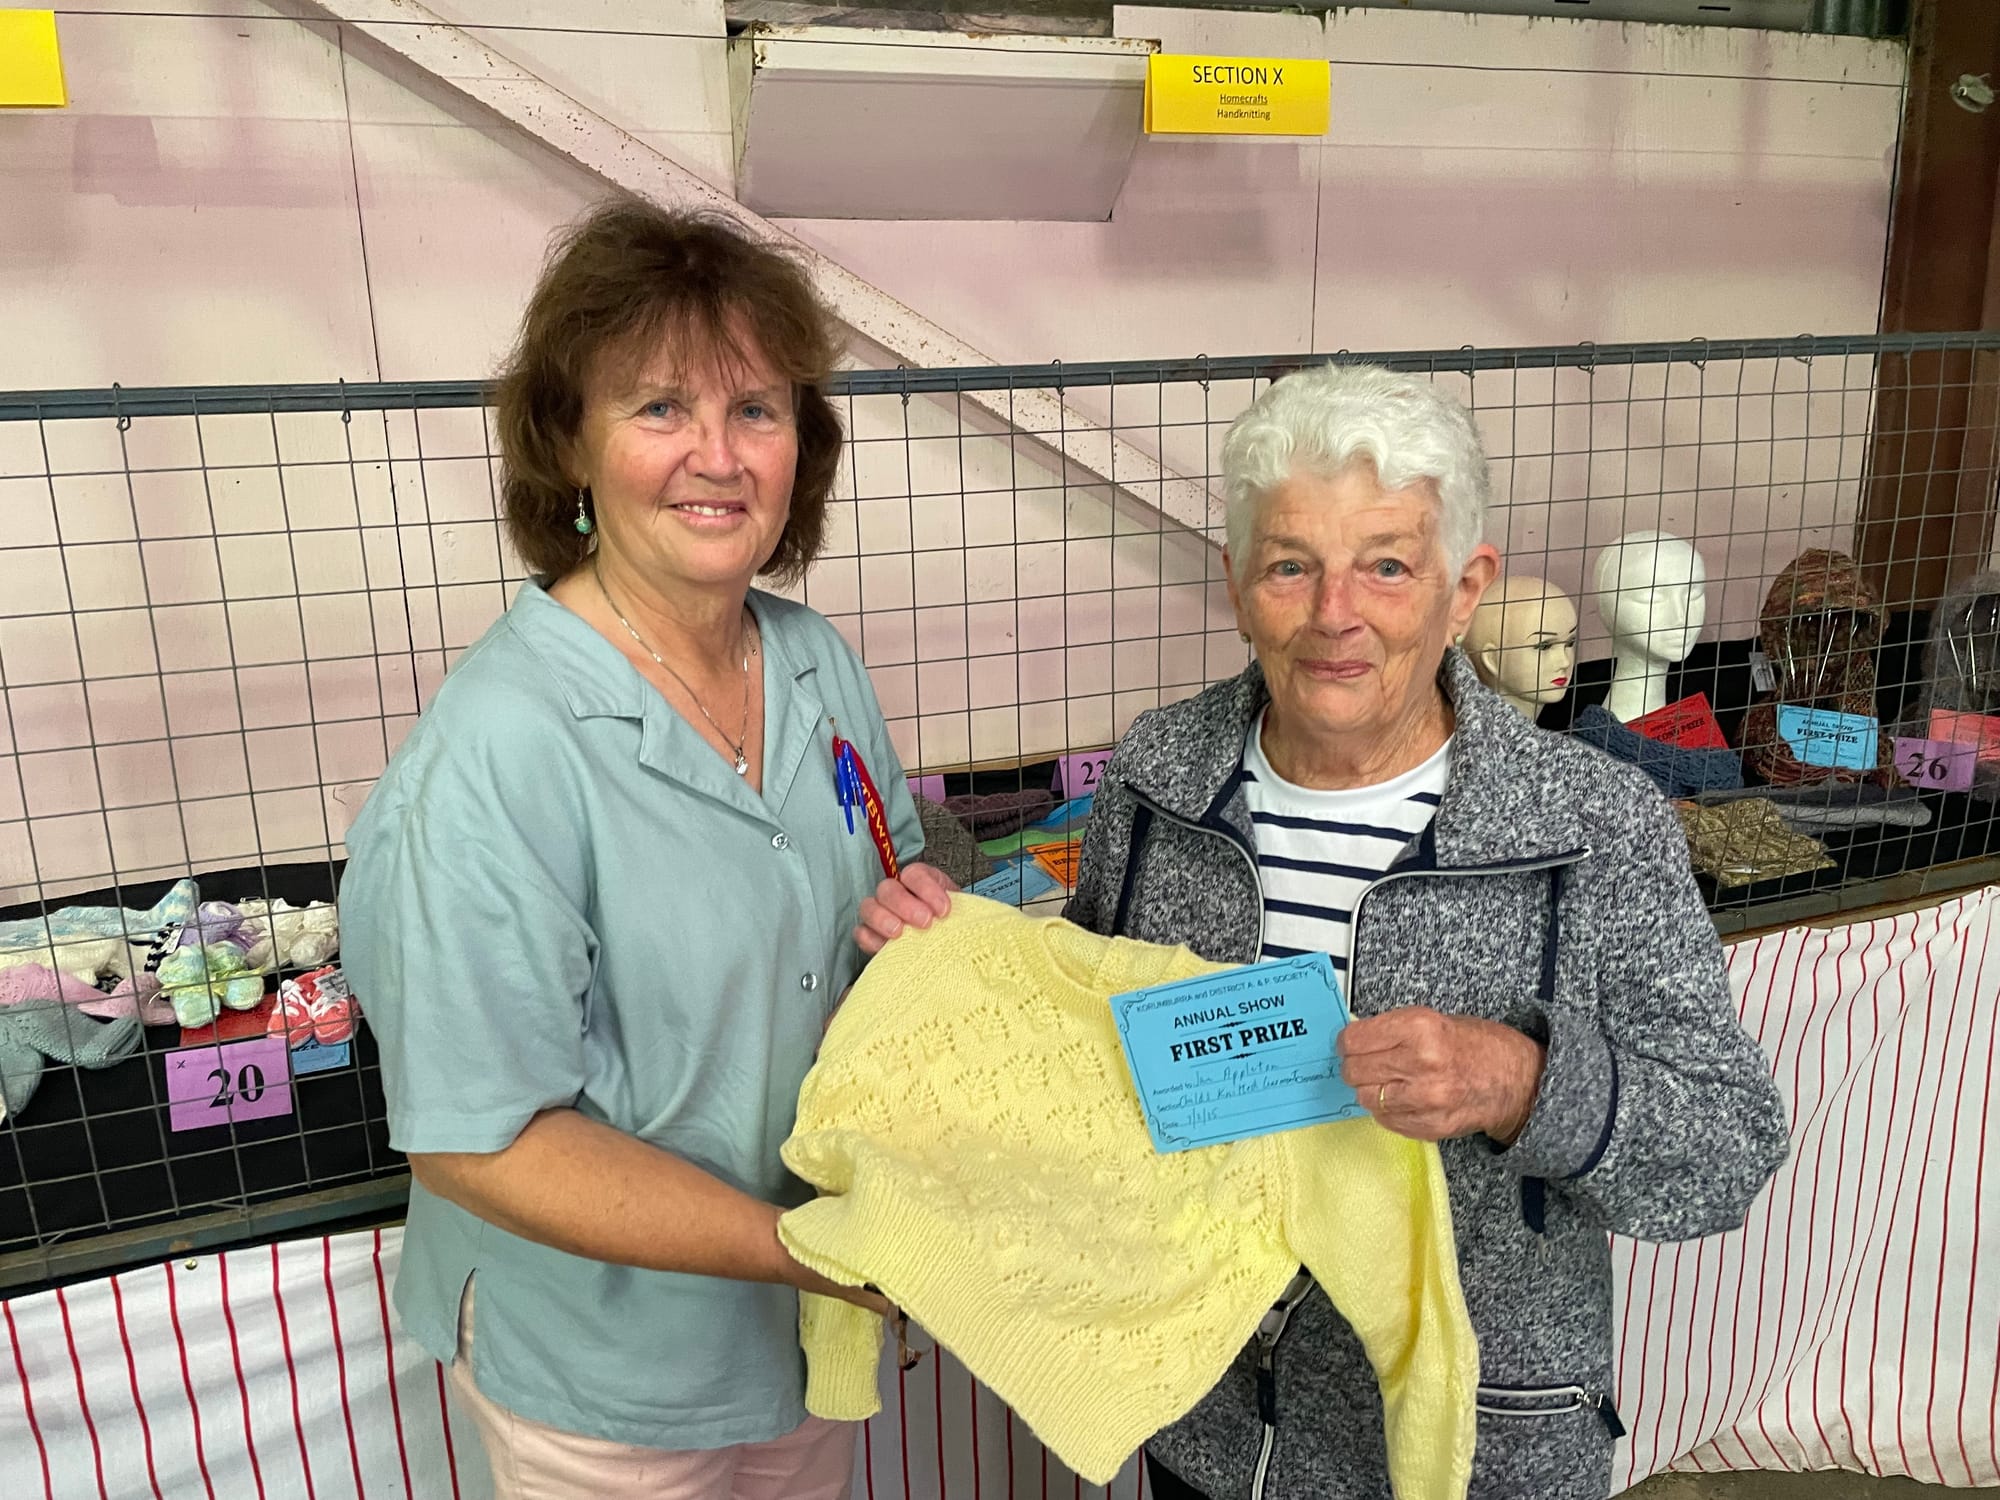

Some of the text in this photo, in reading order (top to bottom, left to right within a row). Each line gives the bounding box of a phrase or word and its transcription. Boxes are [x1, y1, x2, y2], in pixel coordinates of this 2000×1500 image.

[1193, 65, 1284, 85] SECTION X
[1219, 93, 1268, 105] Homecrafts
[1217, 108, 1271, 121] Handknitting
[1796, 728, 1858, 744] FIRST PRIZE
[1905, 752, 1948, 781] 26
[1136, 993, 1194, 1013] KORUMBURRA
[1194, 990, 1208, 1001] and
[1208, 983, 1246, 996] DISTRICT
[1272, 970, 1309, 984] SOCIETY
[1173, 994, 1286, 1029] ANNUAL SHOW
[1170, 1018, 1308, 1062] FIRST PRIZE
[207, 1064, 265, 1108] 20
